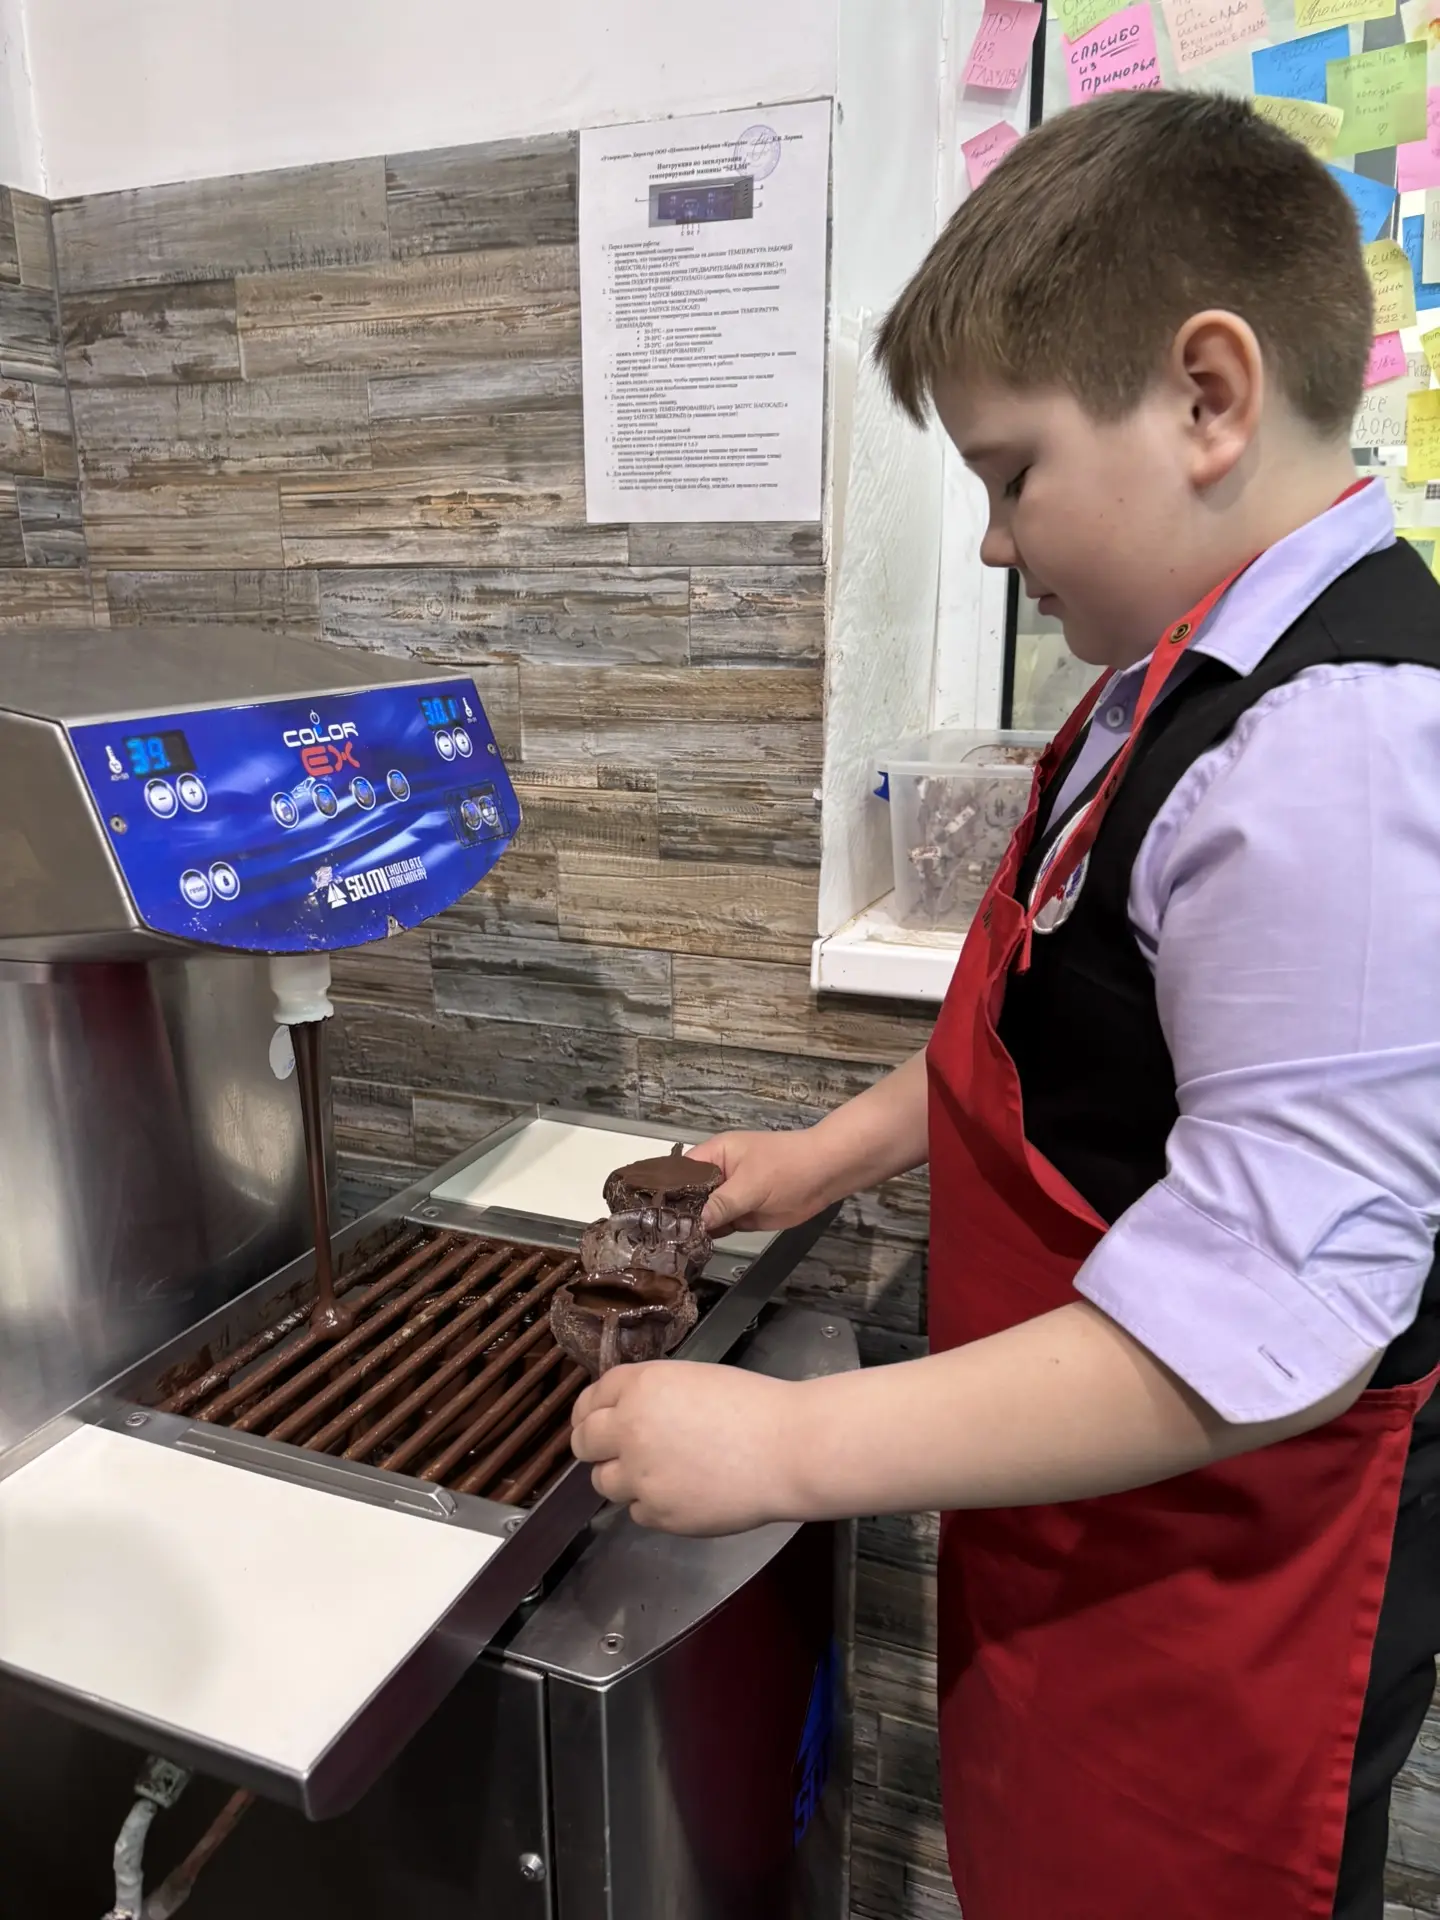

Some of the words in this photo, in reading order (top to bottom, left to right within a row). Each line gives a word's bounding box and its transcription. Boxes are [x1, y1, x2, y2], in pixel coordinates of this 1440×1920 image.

[1070, 24, 1140, 65] СПАСИБО
[282, 722, 359, 748] COLOR
[301, 741, 361, 777] EX
[344, 867, 391, 903] SELMI
[384, 856, 424, 878] CHOCOLATE
[388, 867, 428, 889] MACHINERY
